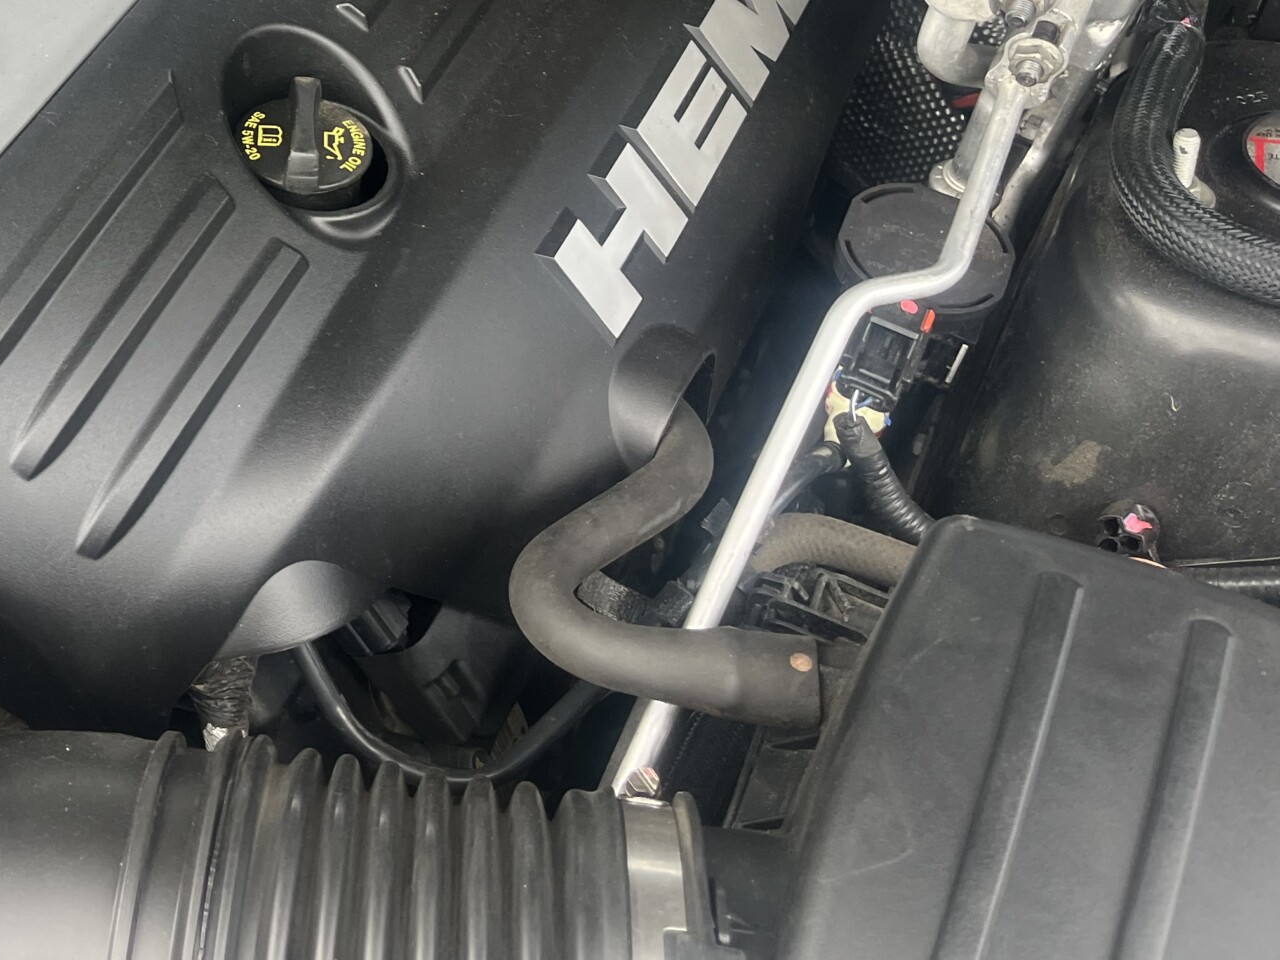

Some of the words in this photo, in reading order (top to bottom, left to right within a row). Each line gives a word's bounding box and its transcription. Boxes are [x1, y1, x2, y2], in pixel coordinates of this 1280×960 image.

[245, 111, 266, 129] SAE
[241, 129, 261, 160] 5W-20
[342, 119, 366, 157] ENGINE
[339, 156, 362, 172] OIL
